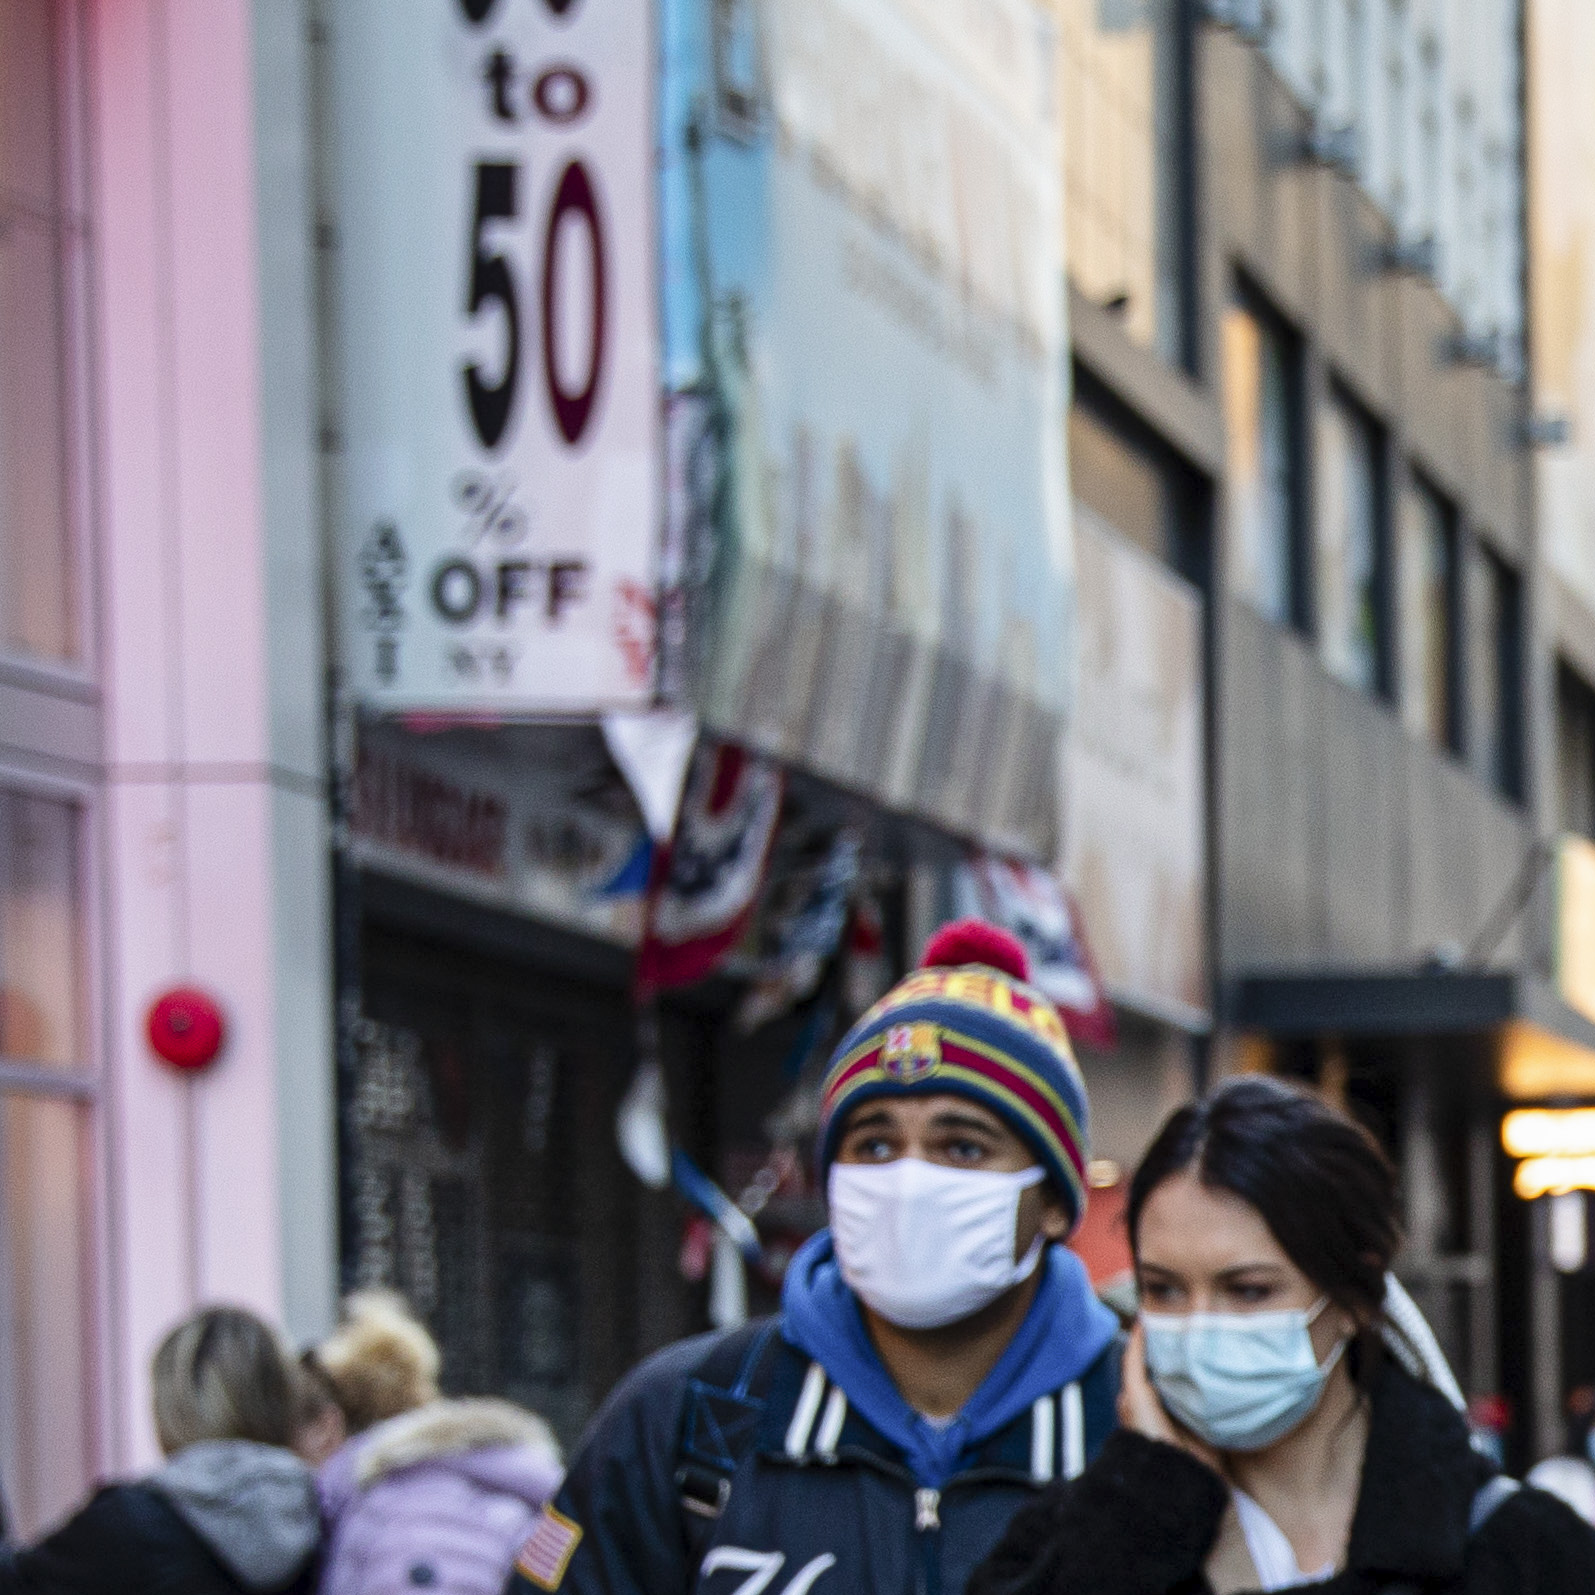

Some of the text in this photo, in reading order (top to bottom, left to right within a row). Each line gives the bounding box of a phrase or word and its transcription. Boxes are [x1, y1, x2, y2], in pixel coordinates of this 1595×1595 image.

[482, 50, 590, 126] to
[461, 156, 610, 452] 50
[430, 557, 588, 628] OFF
